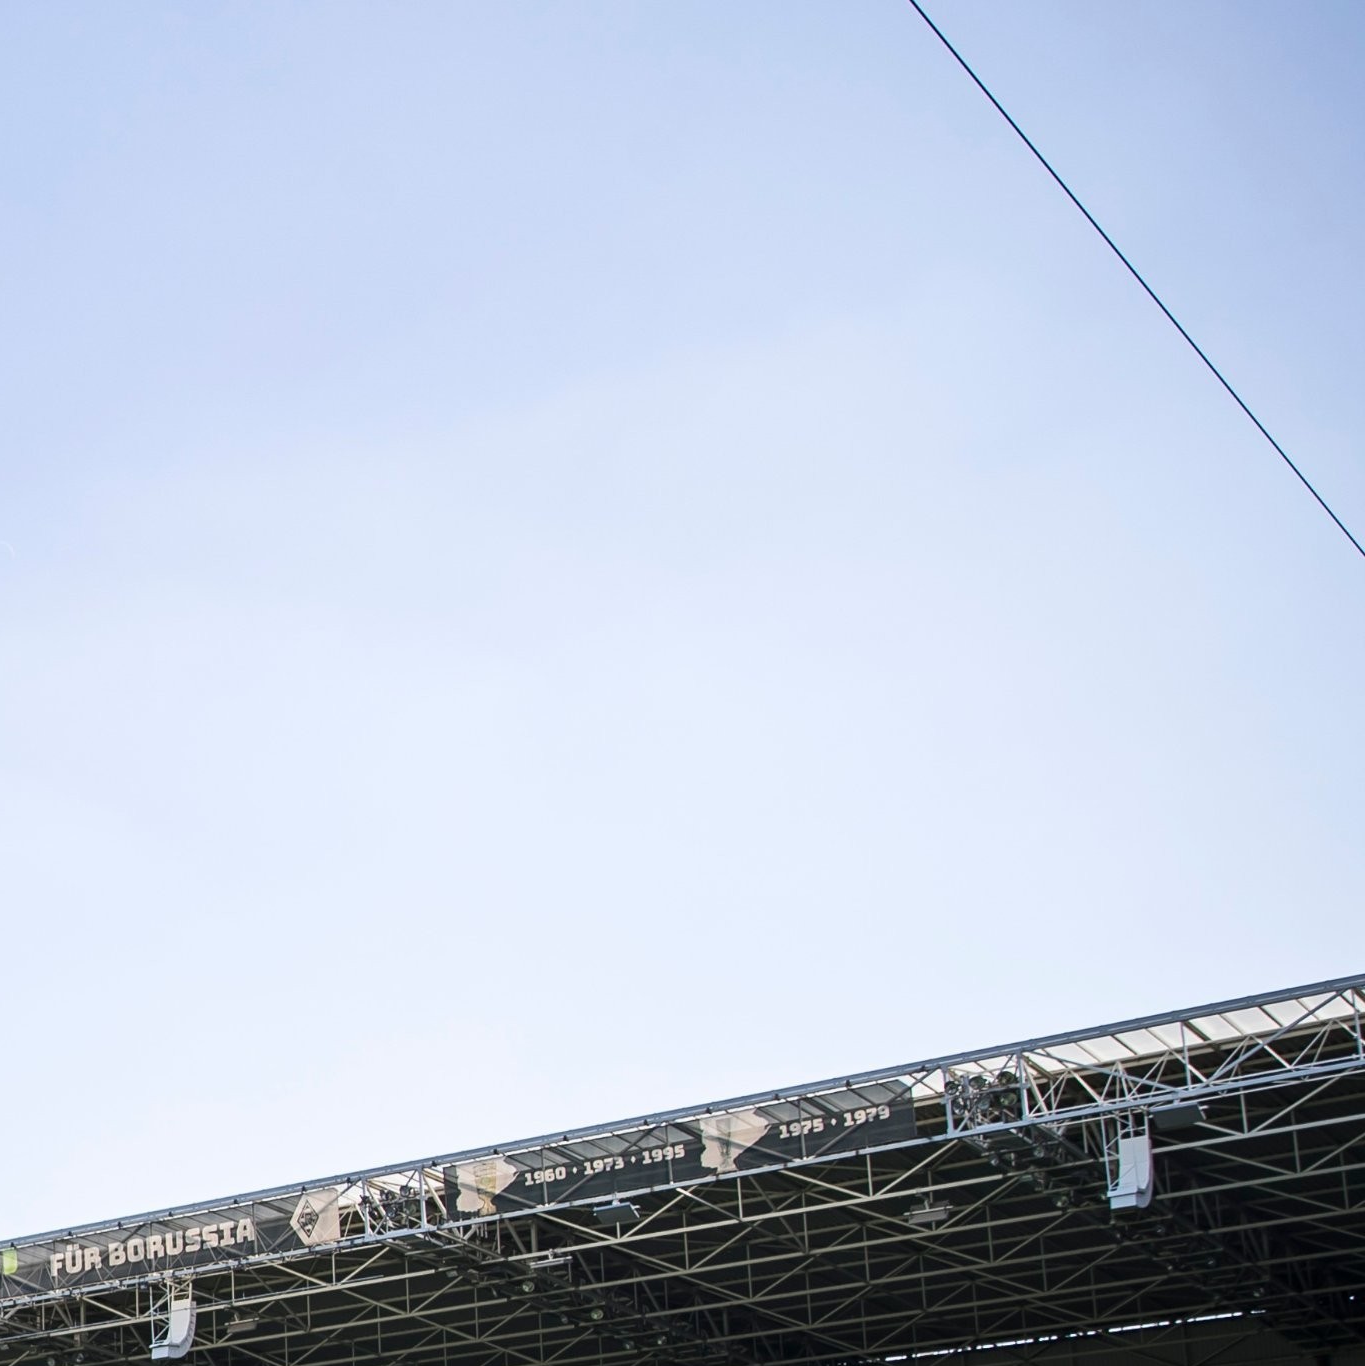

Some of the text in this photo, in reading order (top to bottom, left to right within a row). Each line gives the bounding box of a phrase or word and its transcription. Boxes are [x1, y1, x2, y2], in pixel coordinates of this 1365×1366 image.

[779, 1104, 890, 1139] 1975 1979
[524, 1144, 686, 1187] 1960 1973 1995
[50, 1217, 255, 1278] FÜR BORUSSIA
